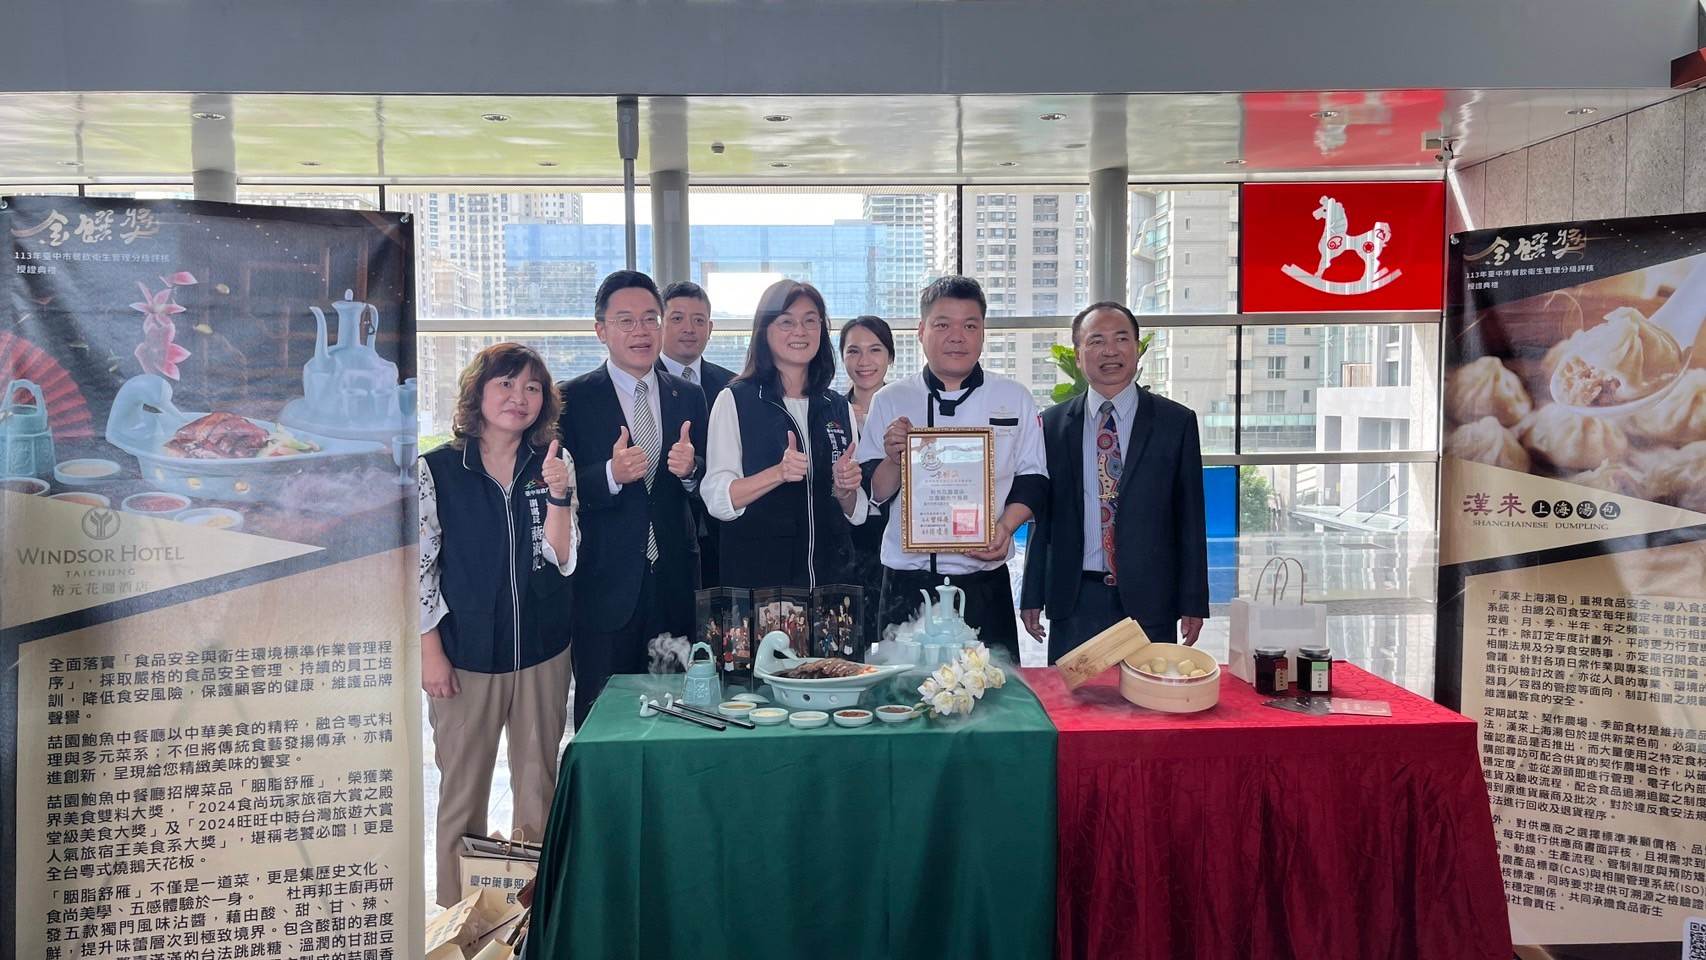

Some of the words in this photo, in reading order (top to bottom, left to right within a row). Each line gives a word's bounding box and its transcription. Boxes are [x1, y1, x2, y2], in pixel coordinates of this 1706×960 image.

[1463, 228, 1587, 266] 金饌獎
[1472, 519, 1549, 529] SHANGHAINESE
[1554, 521, 1609, 530] DUMPLING
[16, 547, 116, 565] WINDSOR
[120, 544, 185, 562] HOTEL
[65, 568, 136, 578] TAICHUNG
[52, 582, 150, 596] 裕元花園酒店
[48, 710, 92, 725] 聲譽。
